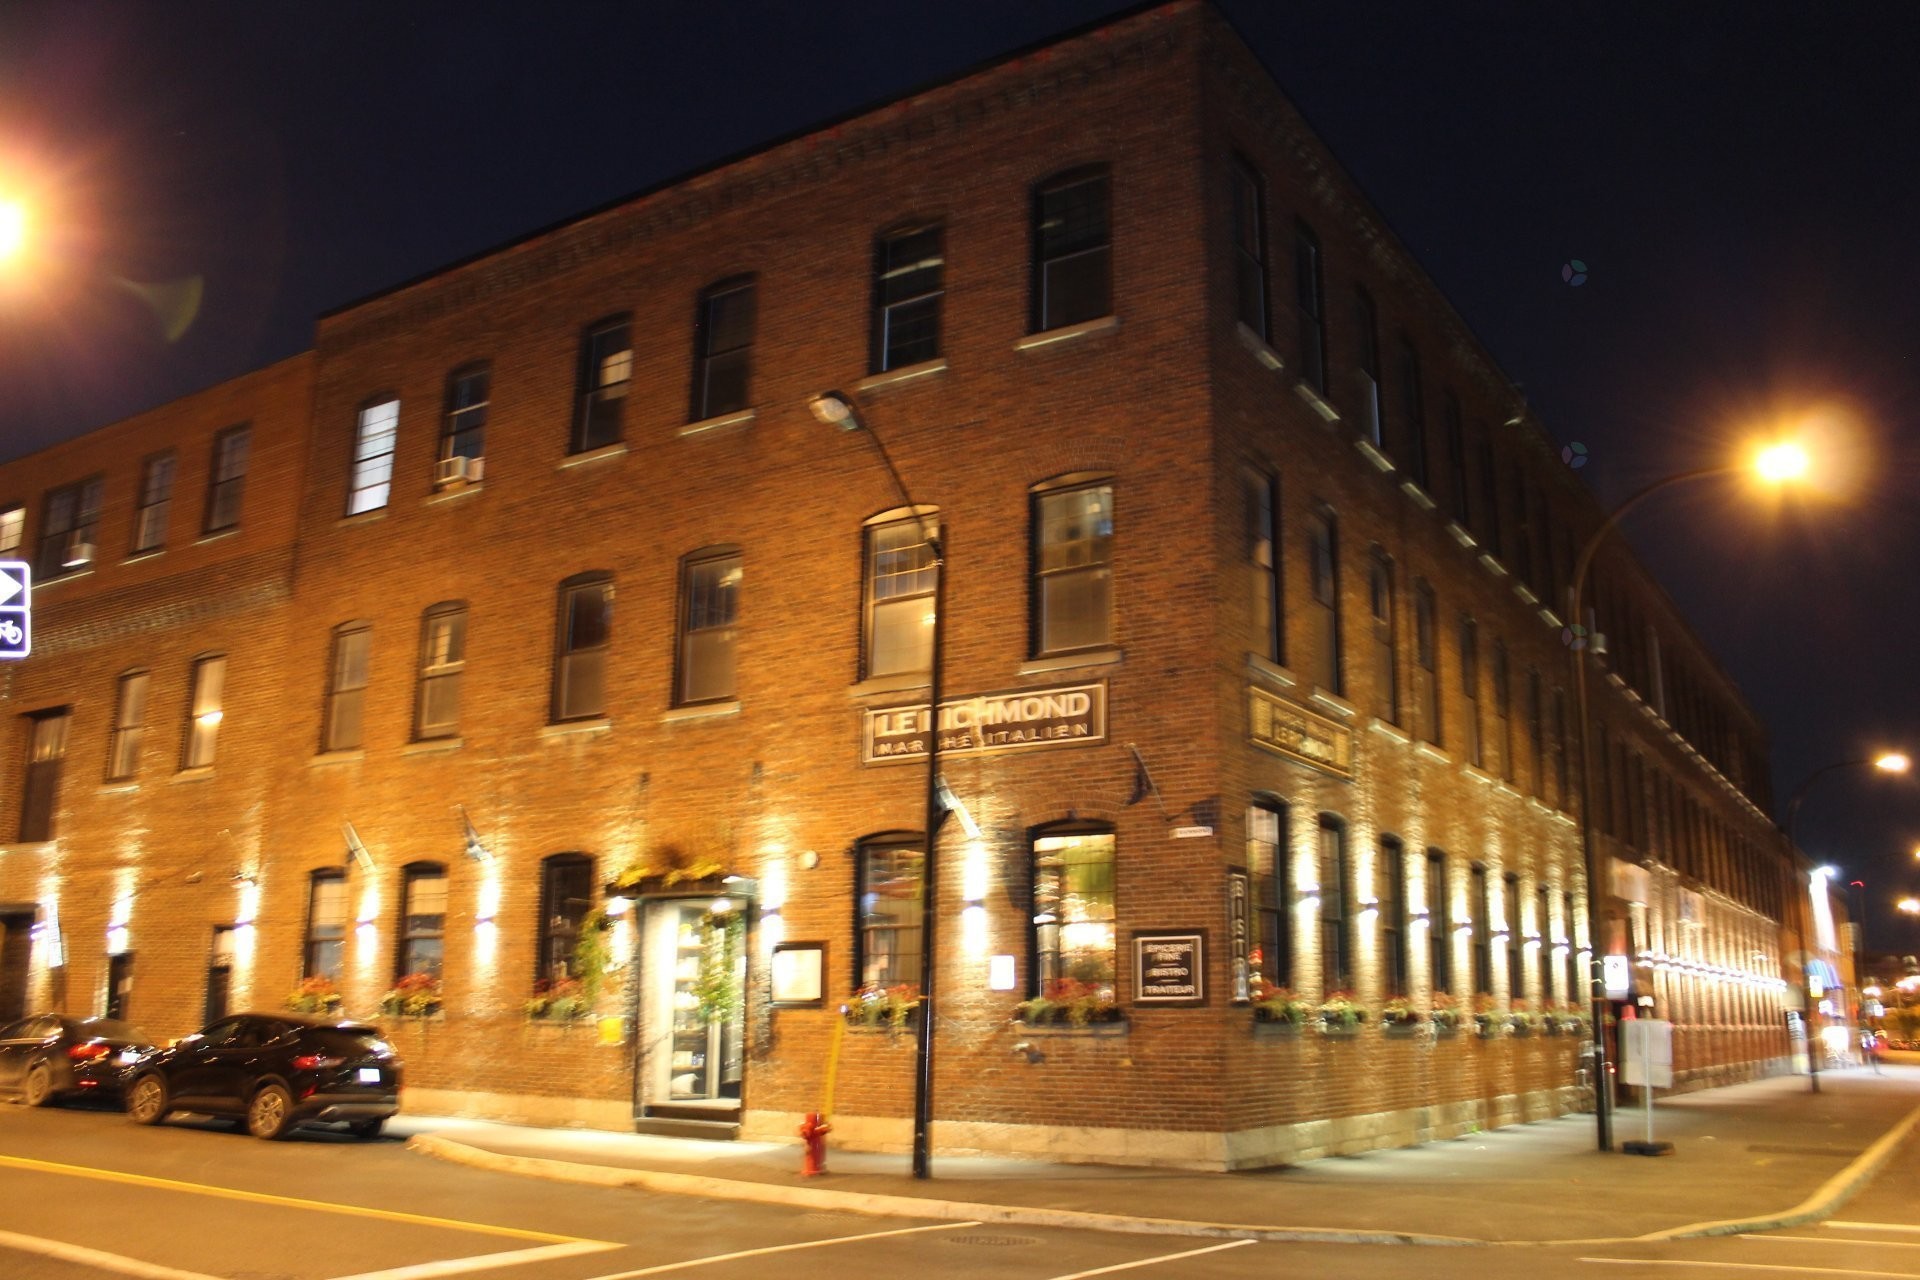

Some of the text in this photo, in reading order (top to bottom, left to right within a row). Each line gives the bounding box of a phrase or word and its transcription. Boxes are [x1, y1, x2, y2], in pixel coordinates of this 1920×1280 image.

[876, 711, 918, 736] LE
[984, 722, 1088, 744] ITALIEN
[1153, 952, 1183, 961] FINE
[1145, 967, 1189, 978] BISTRO
[1142, 984, 1196, 995] TRAITEUR
